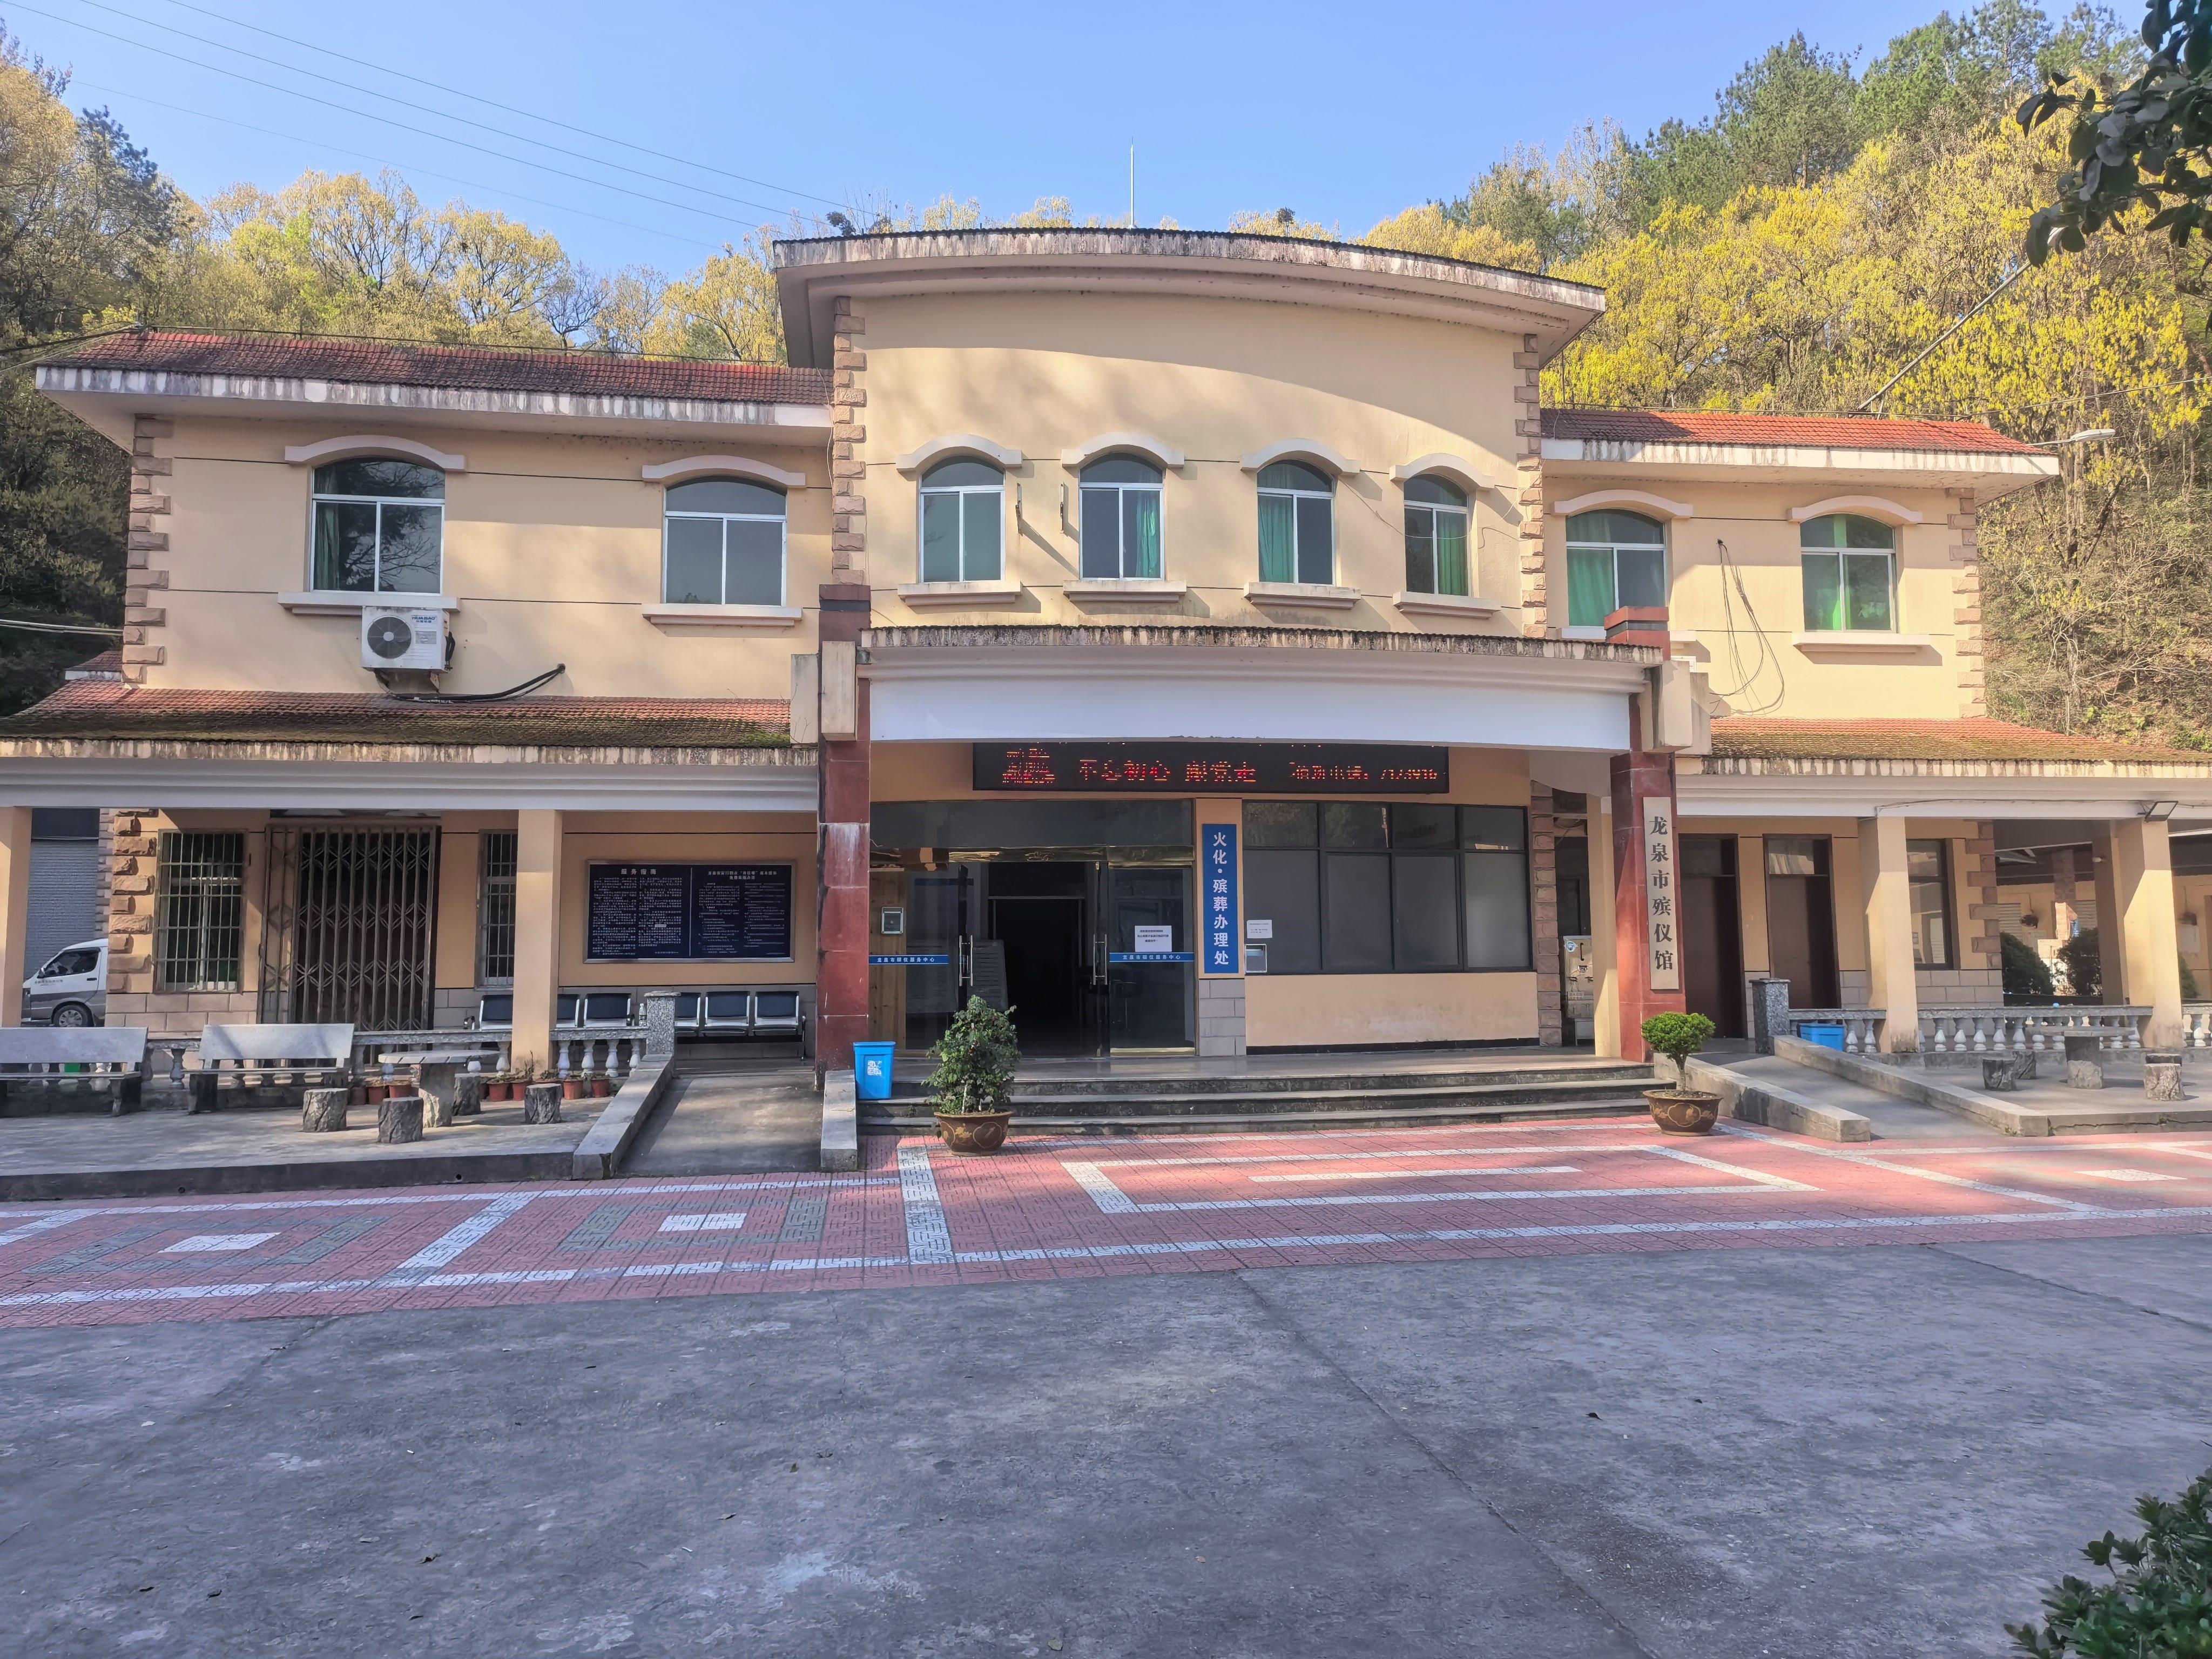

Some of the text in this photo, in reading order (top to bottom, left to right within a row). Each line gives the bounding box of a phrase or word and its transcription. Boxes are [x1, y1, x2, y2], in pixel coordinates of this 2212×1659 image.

[1213, 832, 1229, 965] 火化·殡葬办理处
[1649, 815, 1673, 971] 龙泉市殡仪馆
